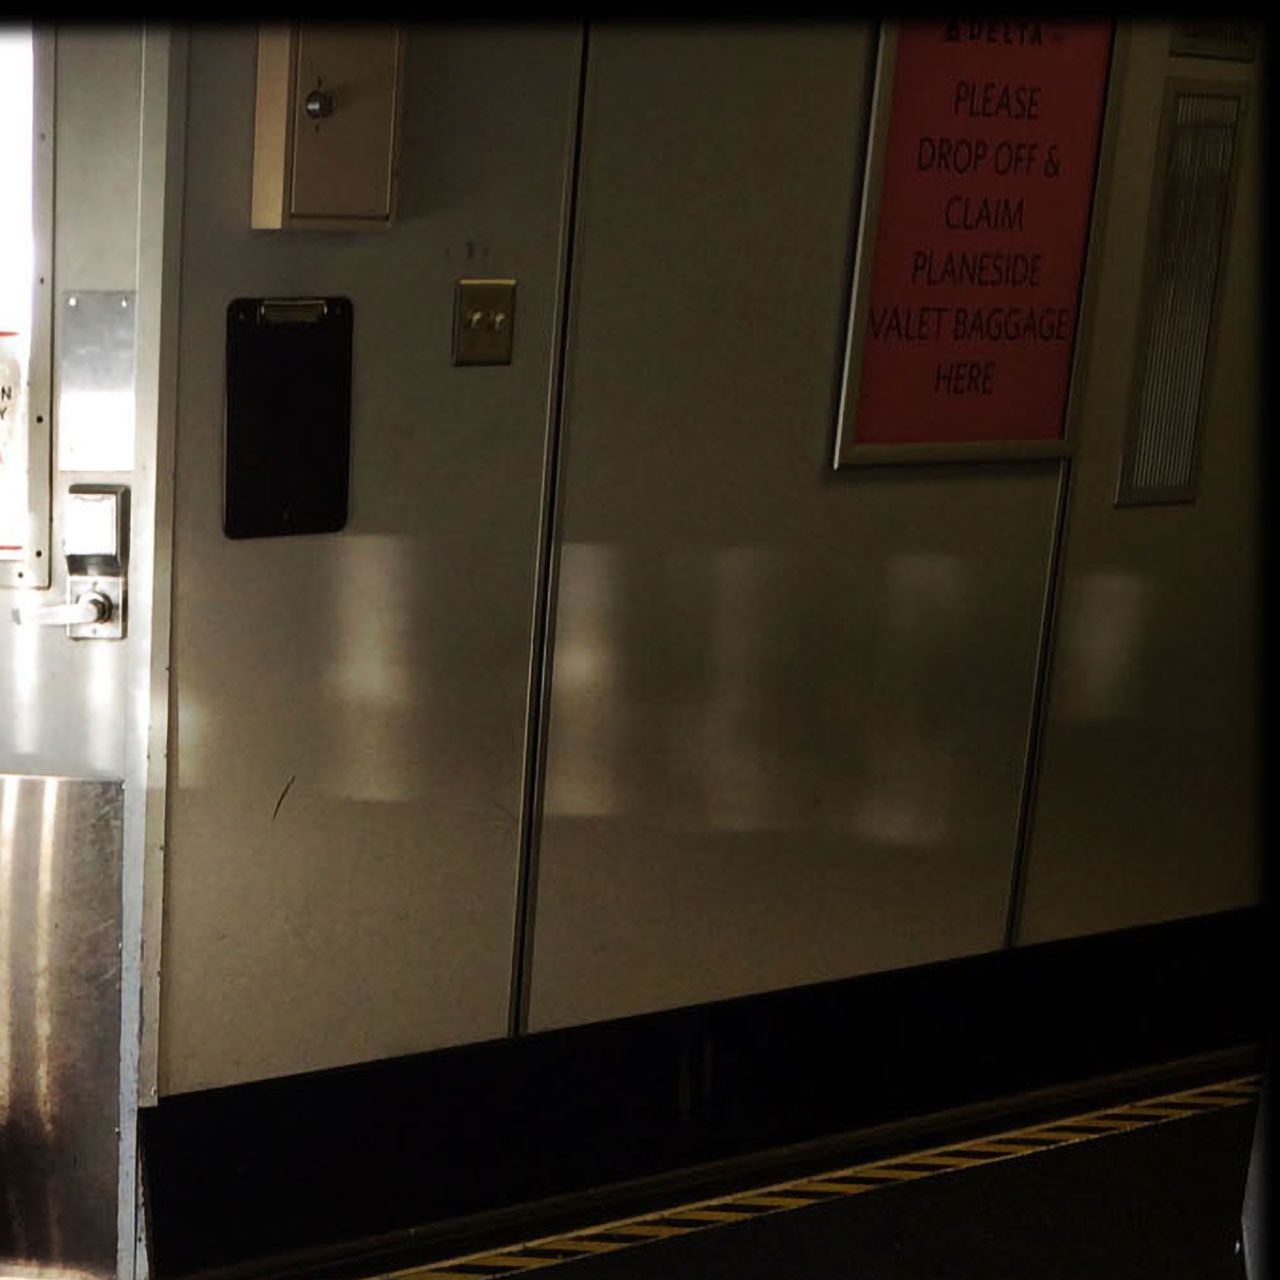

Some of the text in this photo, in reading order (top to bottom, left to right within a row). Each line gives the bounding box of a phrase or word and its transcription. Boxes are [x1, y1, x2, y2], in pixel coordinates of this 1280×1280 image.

[954, 81, 1041, 121] PLEASE
[917, 137, 1061, 178] DROP OFF &
[945, 196, 1025, 231] CLAIM
[912, 251, 1042, 289] PLANESIDE
[869, 306, 1072, 342] VALET BAGGAGE
[934, 361, 997, 396] HERE
